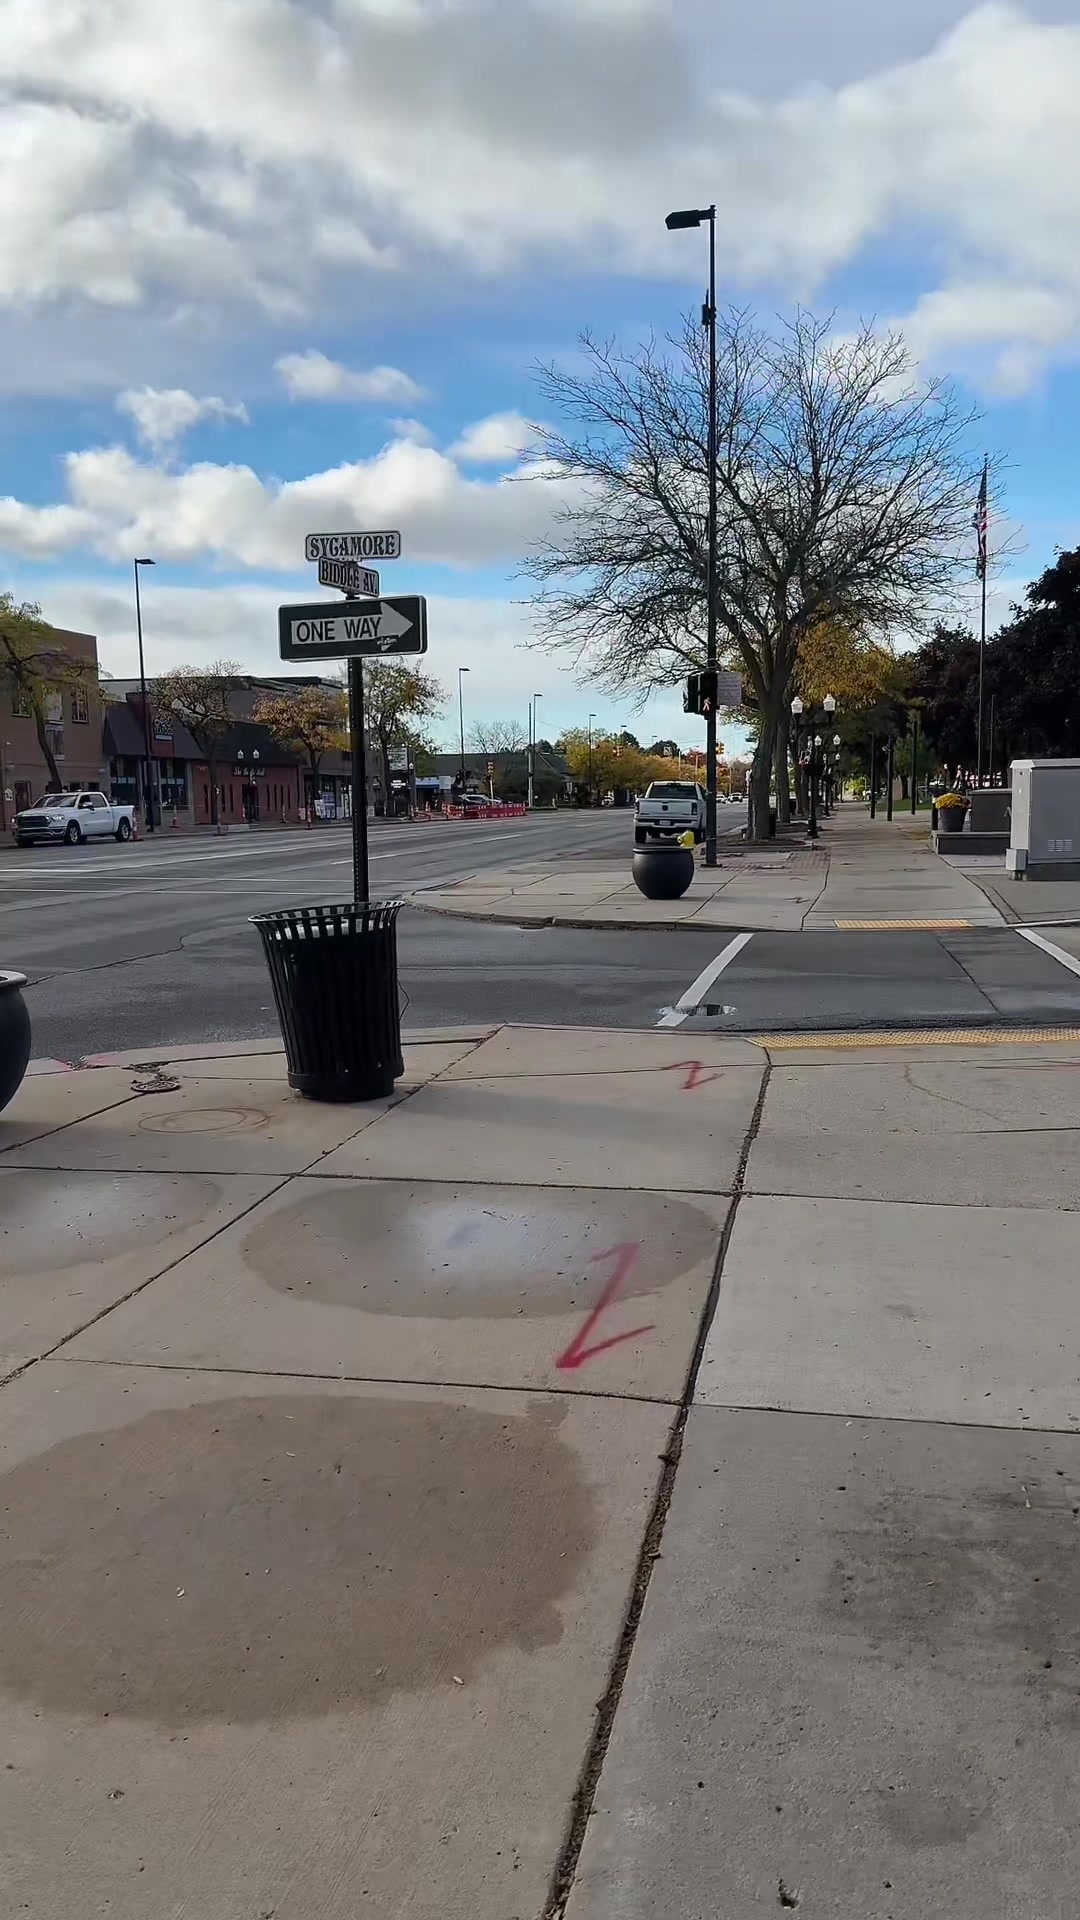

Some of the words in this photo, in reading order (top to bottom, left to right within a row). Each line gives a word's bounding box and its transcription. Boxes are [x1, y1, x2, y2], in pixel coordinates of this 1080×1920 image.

[310, 535, 396, 558] SYCAMORE
[321, 560, 360, 588] BIDDLE
[296, 620, 336, 643] ONE
[343, 616, 382, 639] WAY
